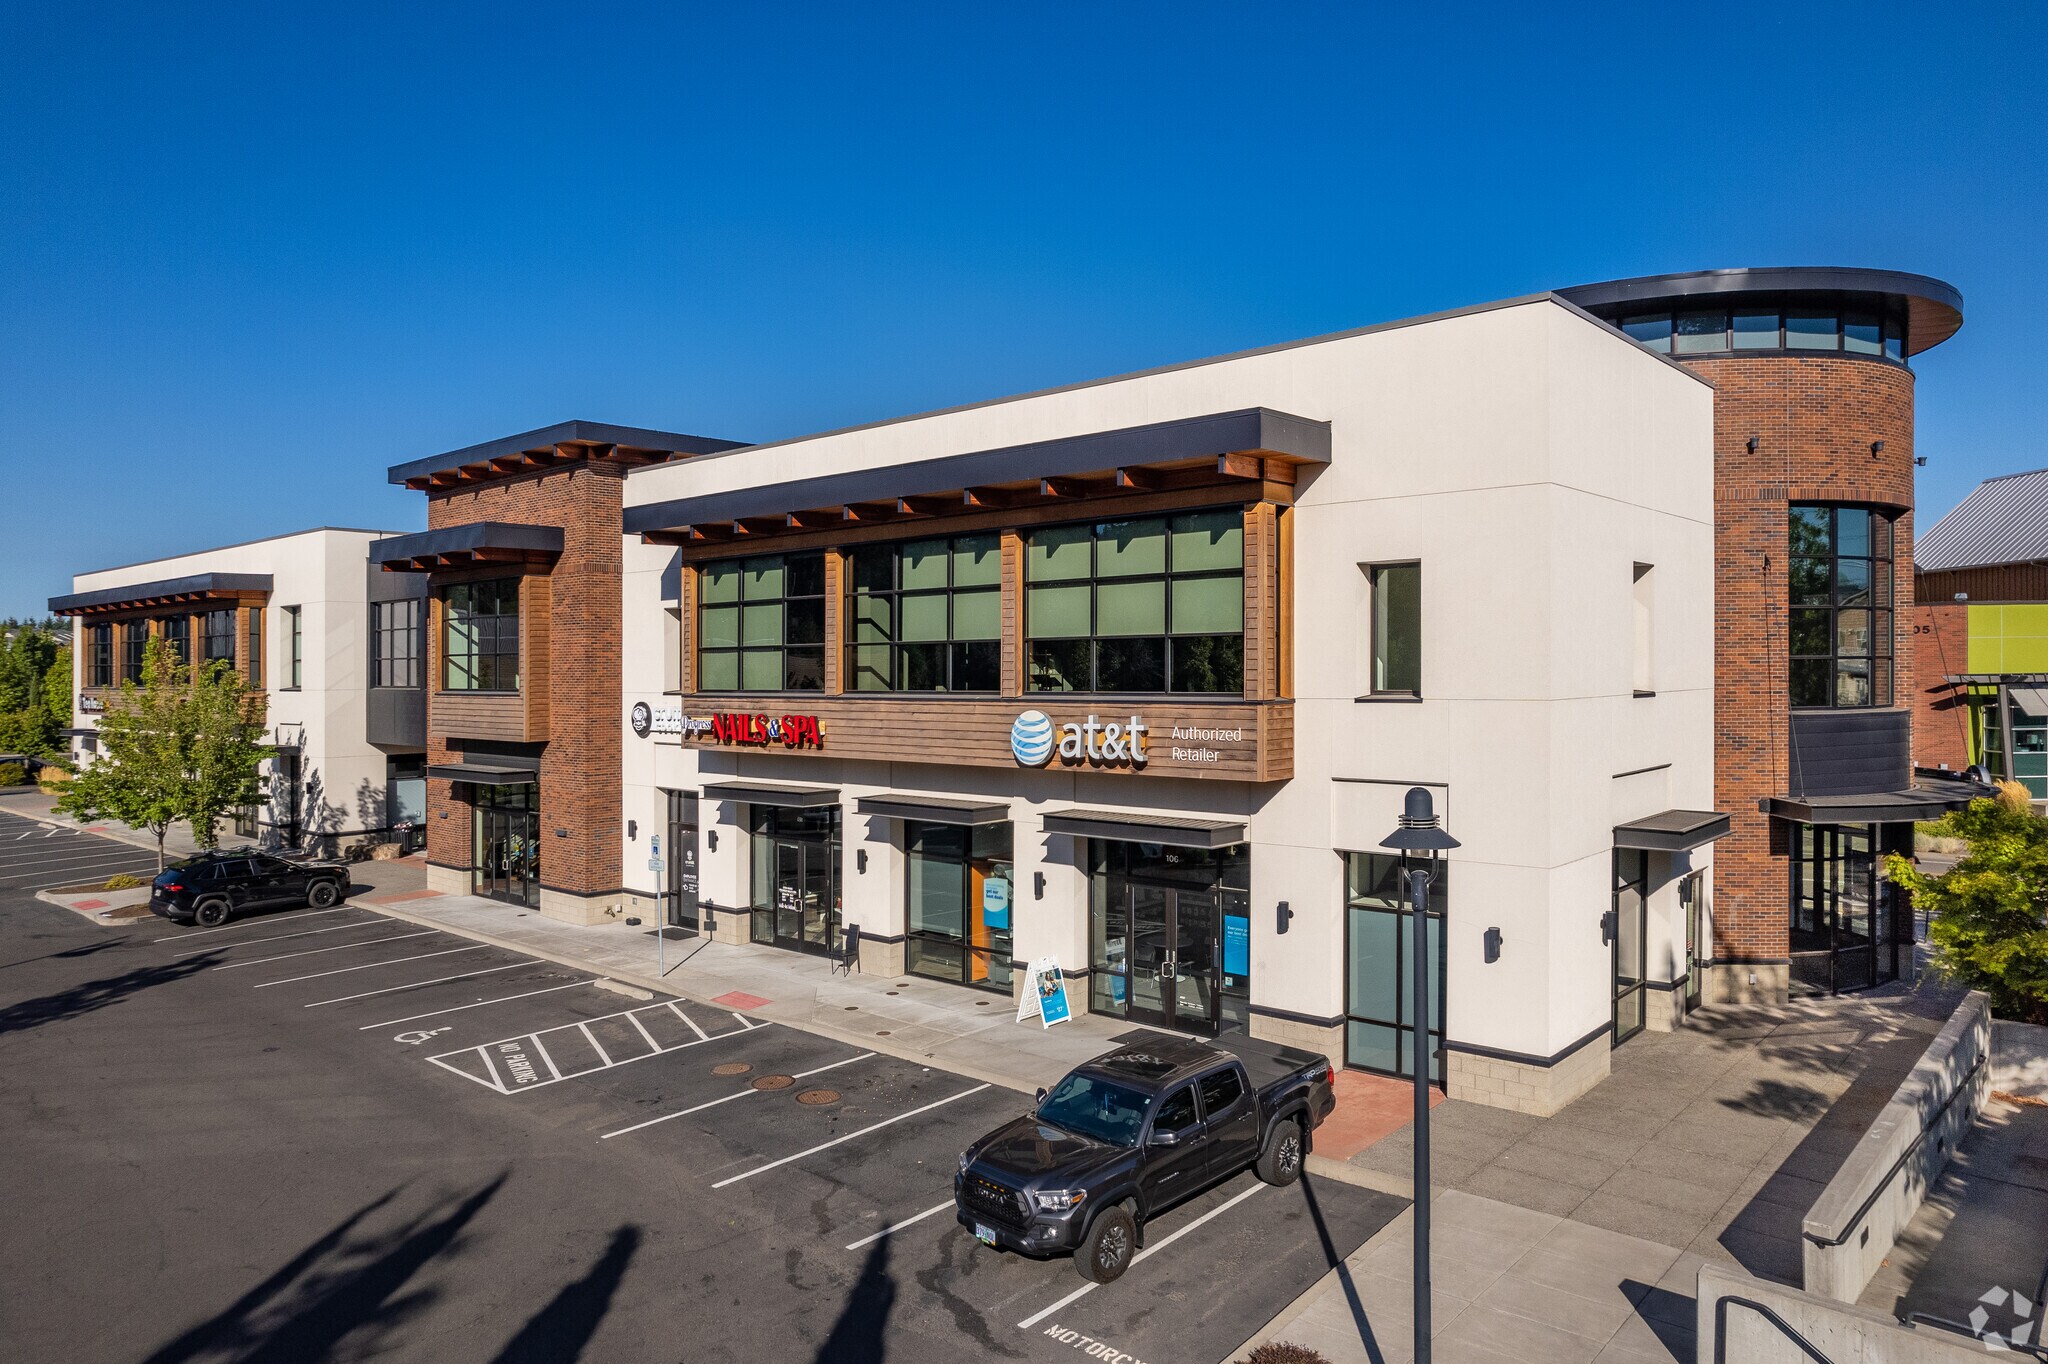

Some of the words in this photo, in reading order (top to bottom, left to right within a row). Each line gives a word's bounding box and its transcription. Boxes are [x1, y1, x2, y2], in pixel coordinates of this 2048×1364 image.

[712, 712, 767, 743] NAILS
[769, 719, 780, 738] &
[781, 714, 820, 745] SPA
[1058, 714, 1149, 762] at&t
[1171, 726, 1242, 742] Authorized
[1171, 747, 1220, 762] Retailer
[498, 1042, 521, 1053] NO
[505, 1054, 538, 1083] PARKING
[1043, 1323, 1148, 1364] MOTORC
